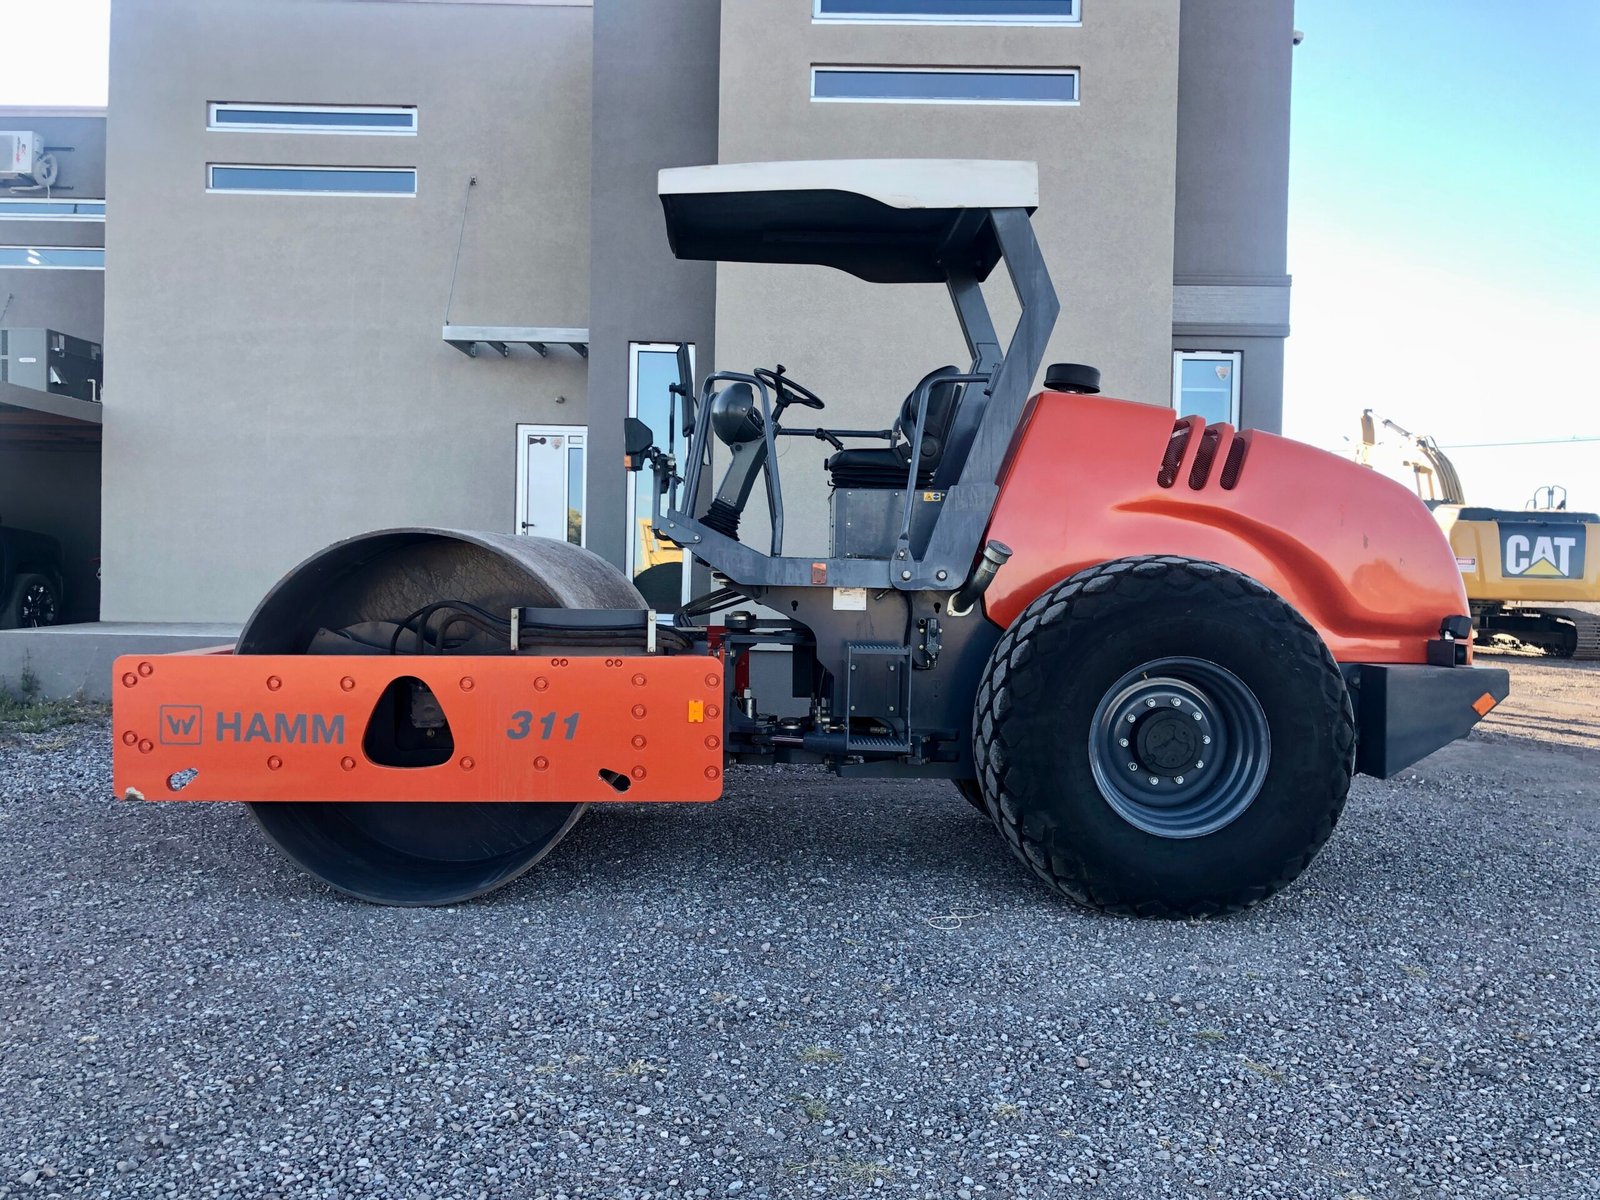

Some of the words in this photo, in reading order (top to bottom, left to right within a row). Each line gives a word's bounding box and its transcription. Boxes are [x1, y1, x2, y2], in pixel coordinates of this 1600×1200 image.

[1506, 534, 1576, 576] CAT
[215, 711, 345, 744] HAMM
[506, 710, 581, 740] 311
